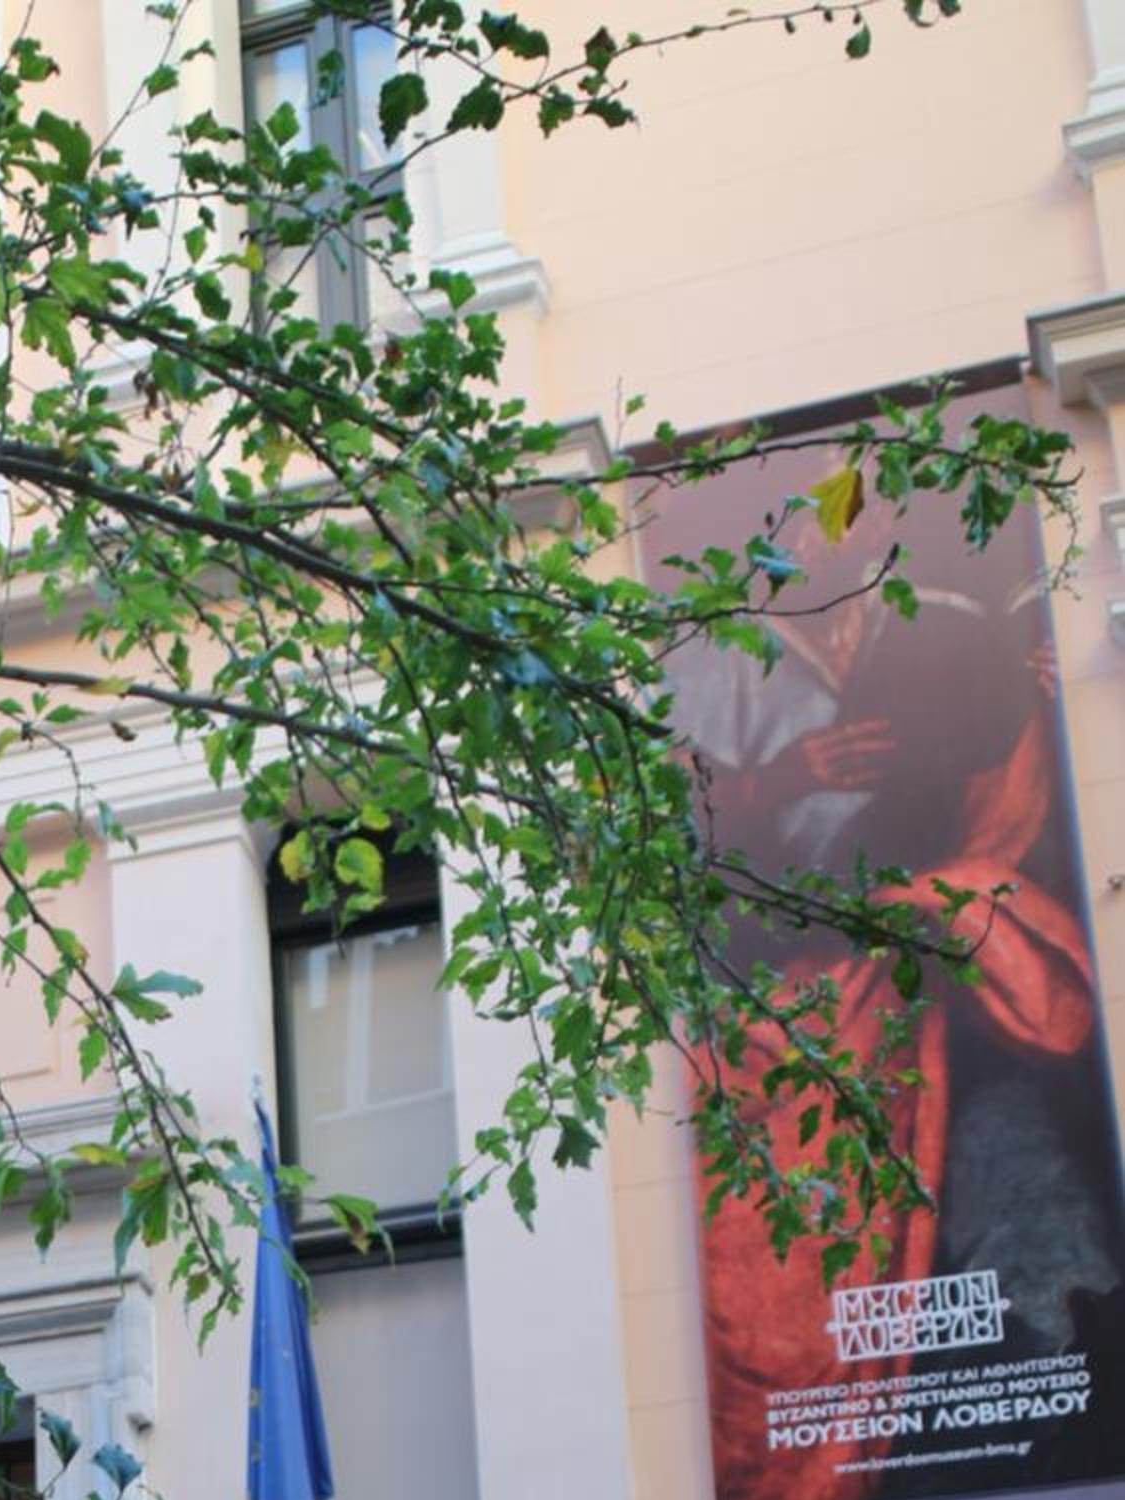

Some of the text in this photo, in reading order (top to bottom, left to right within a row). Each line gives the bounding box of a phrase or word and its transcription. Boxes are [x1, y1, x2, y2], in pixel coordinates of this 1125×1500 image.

[767, 1370, 1091, 1425] ΒΥΖΑΝΤΙΝΟ & ΧΡΙΣΤΙΑΝΙΚΟ ΜΟΥΣΕΙΟ
[953, 1367, 979, 1383] ΚΑΙ
[769, 1388, 1091, 1450] ΜΟΥΣΕΙΟΝ ΛΟΒΕΡΔΟΥ
